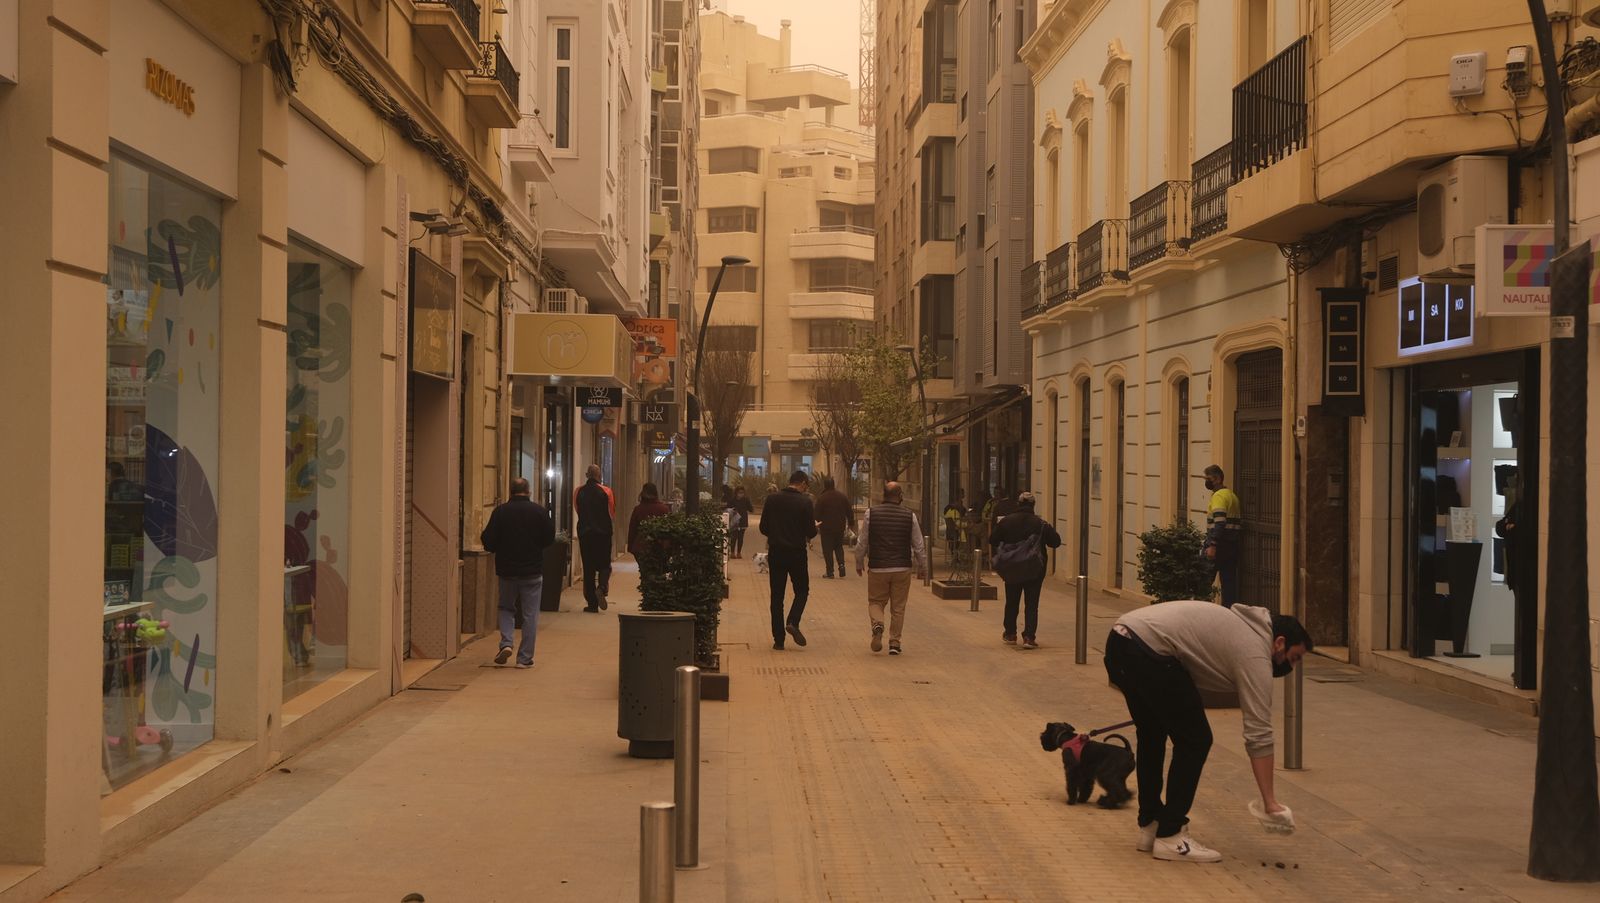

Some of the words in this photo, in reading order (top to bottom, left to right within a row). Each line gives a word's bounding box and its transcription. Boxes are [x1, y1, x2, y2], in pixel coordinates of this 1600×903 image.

[145, 57, 195, 116] RIZOMAS
[1430, 304, 1439, 316] SA
[1455, 298, 1464, 311] KO
[1503, 294, 1551, 304] NAUTALI
